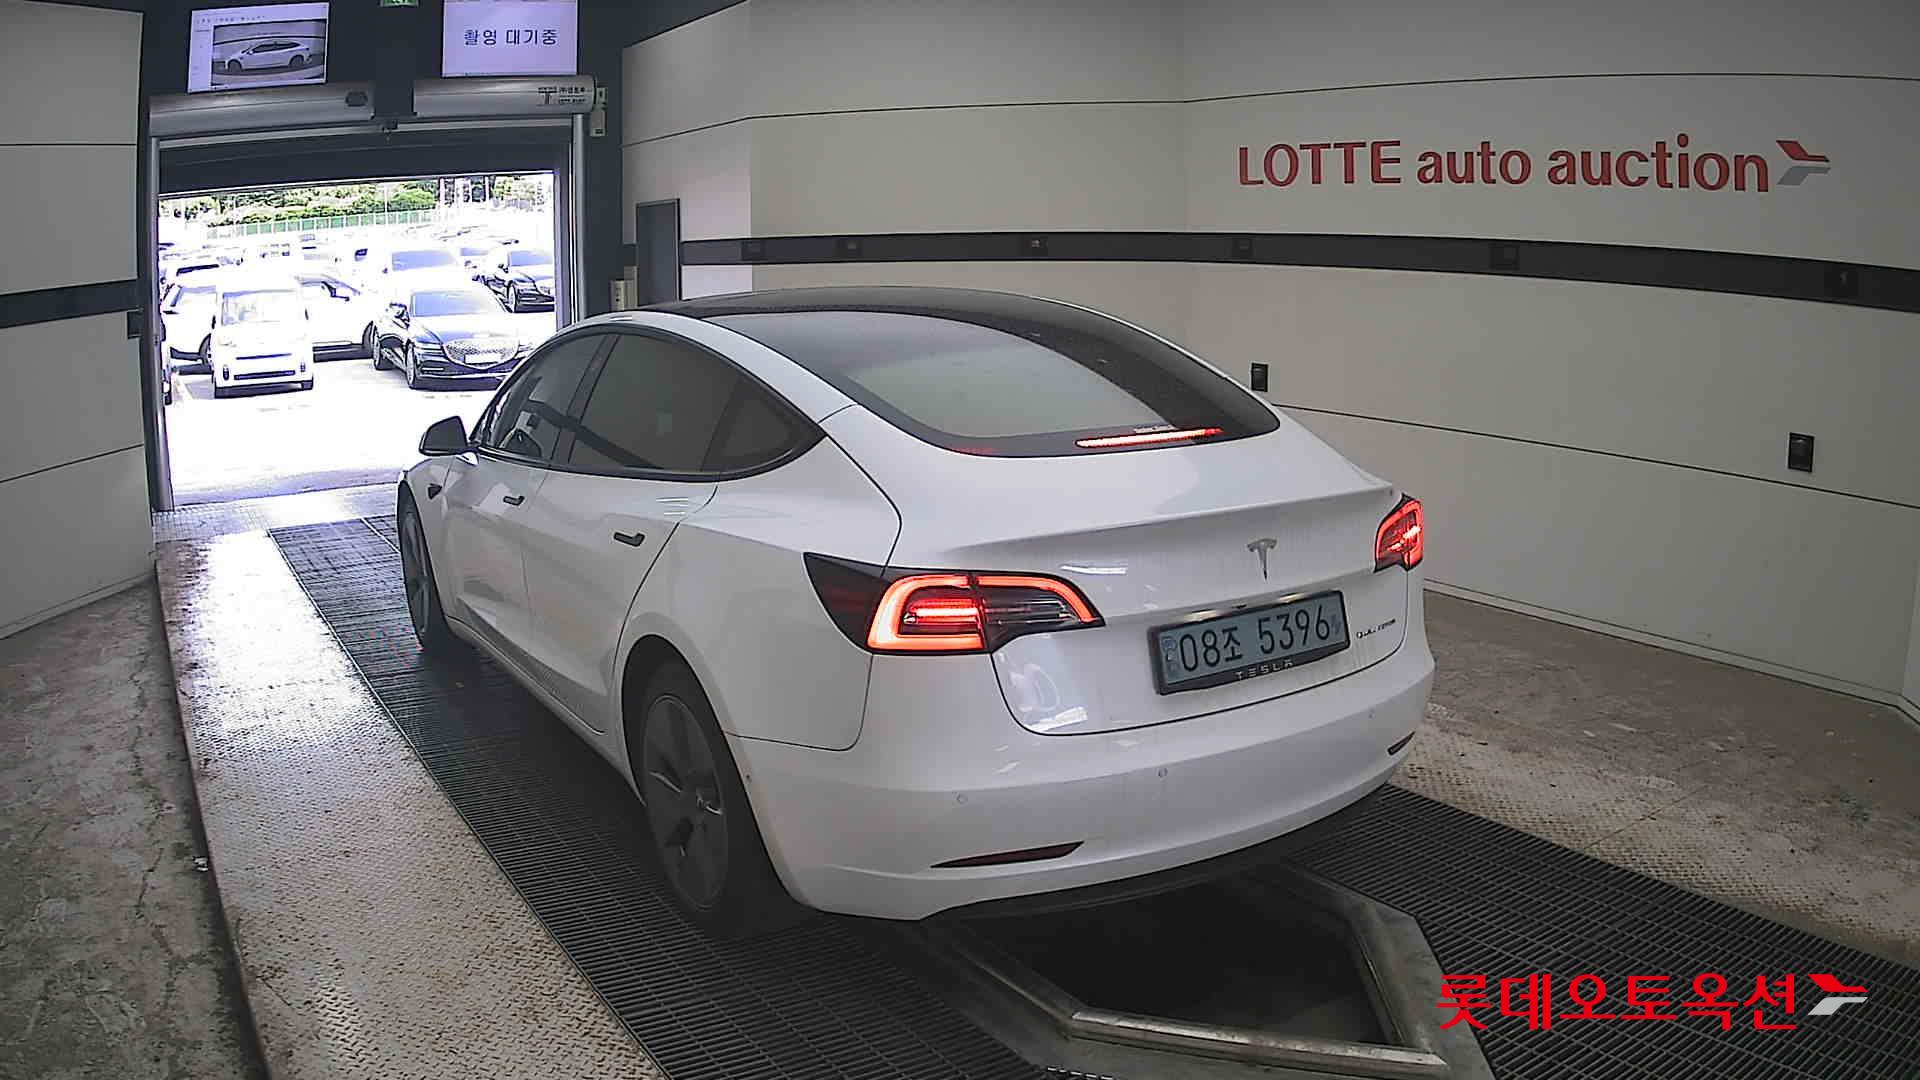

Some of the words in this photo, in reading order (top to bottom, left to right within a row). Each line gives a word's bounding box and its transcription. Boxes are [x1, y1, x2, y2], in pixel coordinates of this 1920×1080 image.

[464, 29, 497, 46] 촬영
[505, 29, 558, 46] 대기중
[1239, 140, 1401, 187] LOTTE
[1417, 141, 1532, 186] auto
[1547, 133, 1769, 193] auction
[1179, 626, 1243, 673] 08조
[1257, 604, 1331, 655] 5396
[1235, 659, 1294, 680] TESLA
